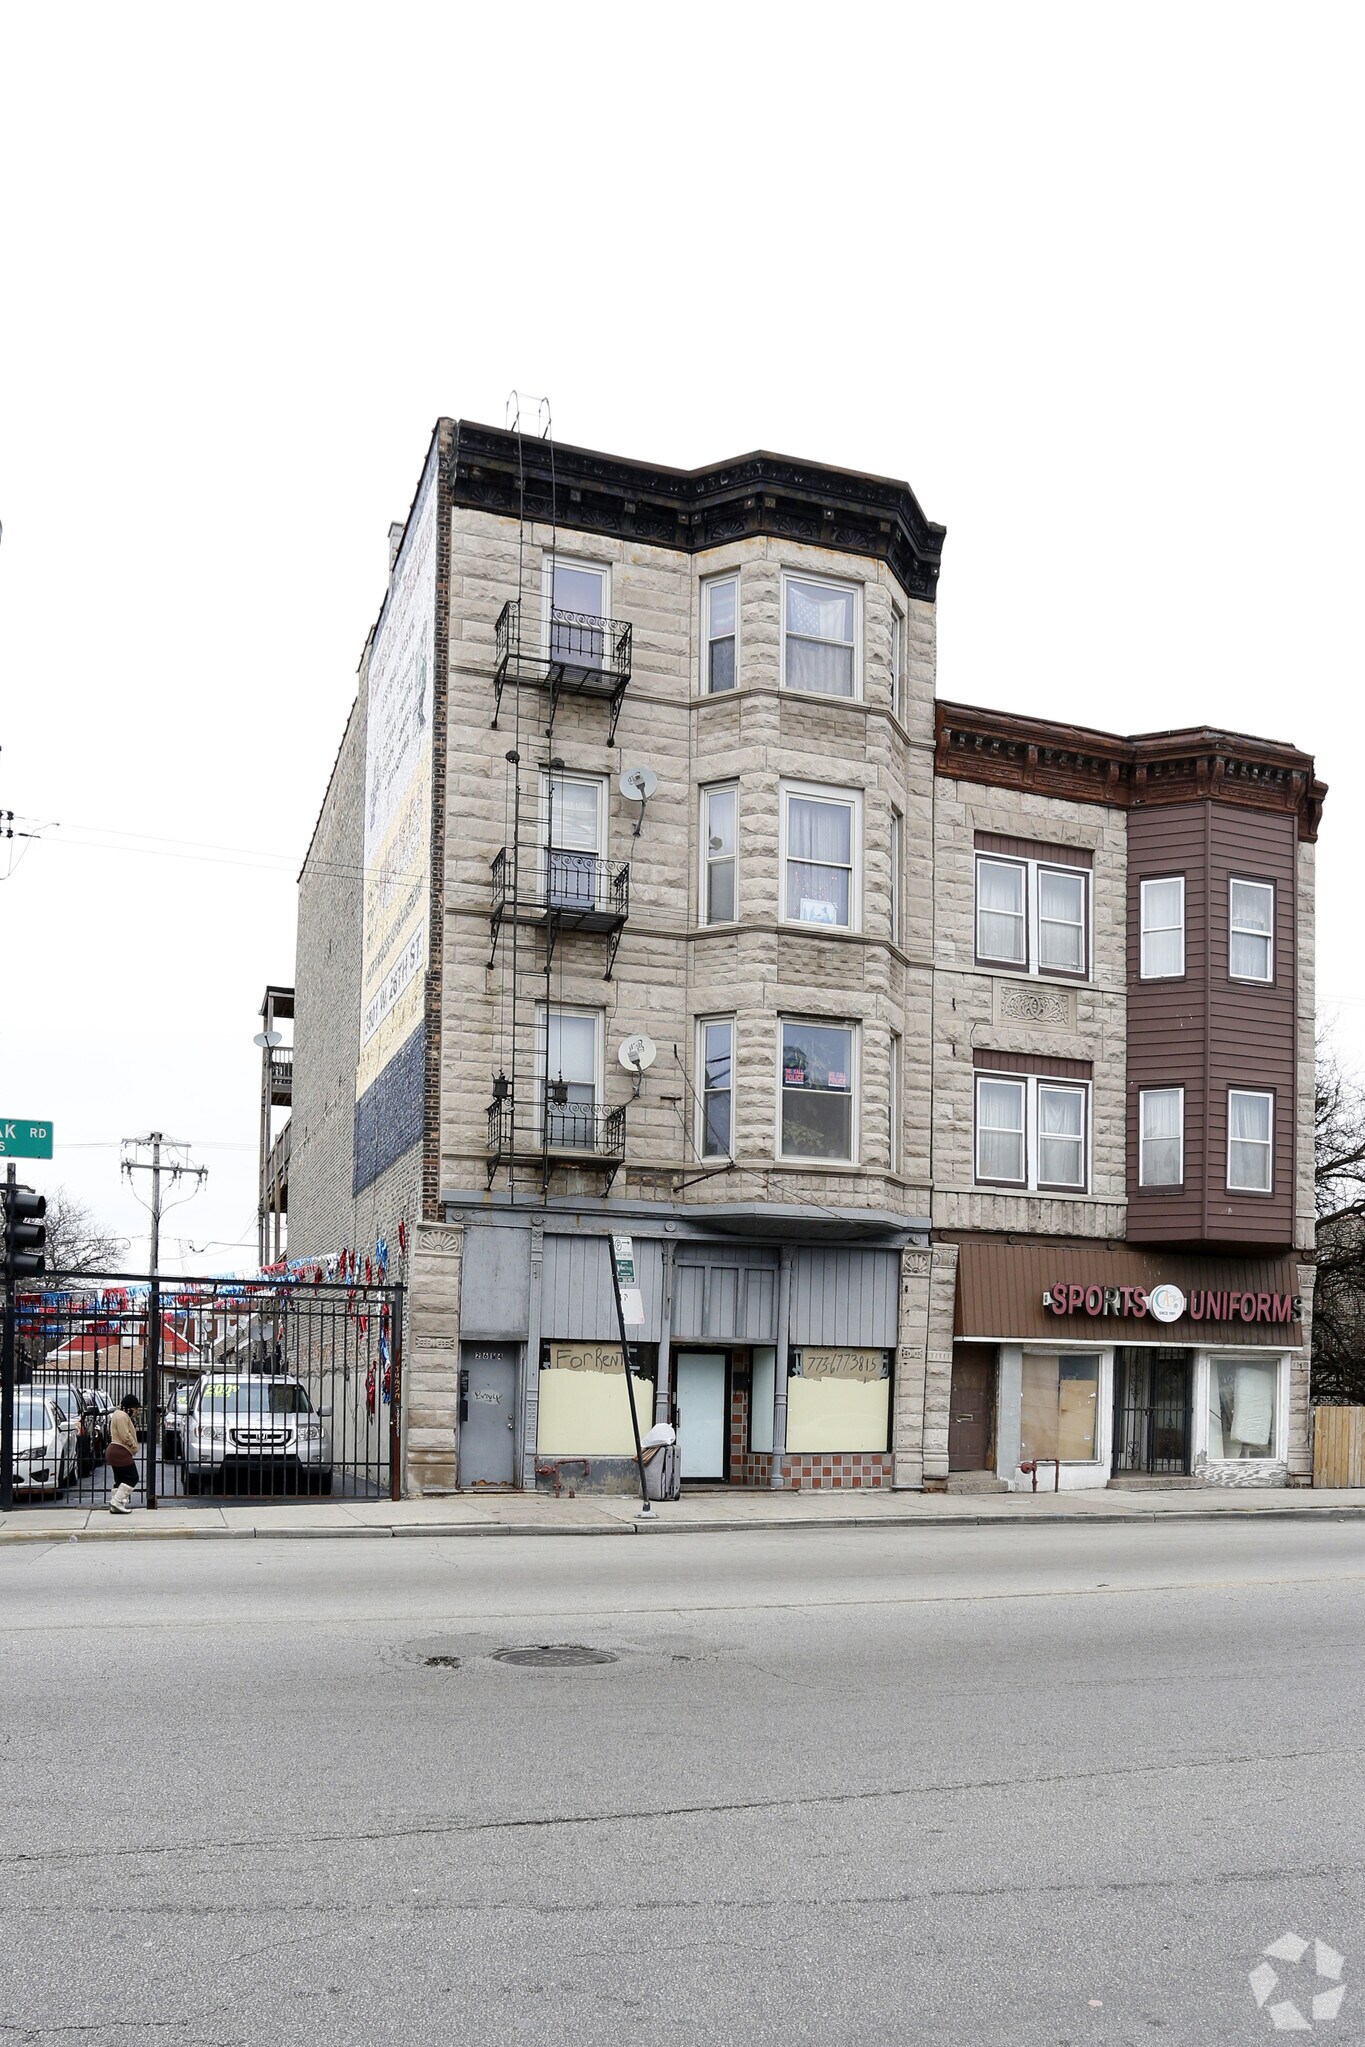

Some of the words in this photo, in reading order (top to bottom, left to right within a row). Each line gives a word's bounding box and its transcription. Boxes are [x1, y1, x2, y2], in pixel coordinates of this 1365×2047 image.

[828, 1077, 847, 1085] POLICE
[30, 1128, 47, 1139] RD
[1052, 1282, 1148, 1318] SPORTS
[1190, 1289, 1304, 1322] UNIFORMS
